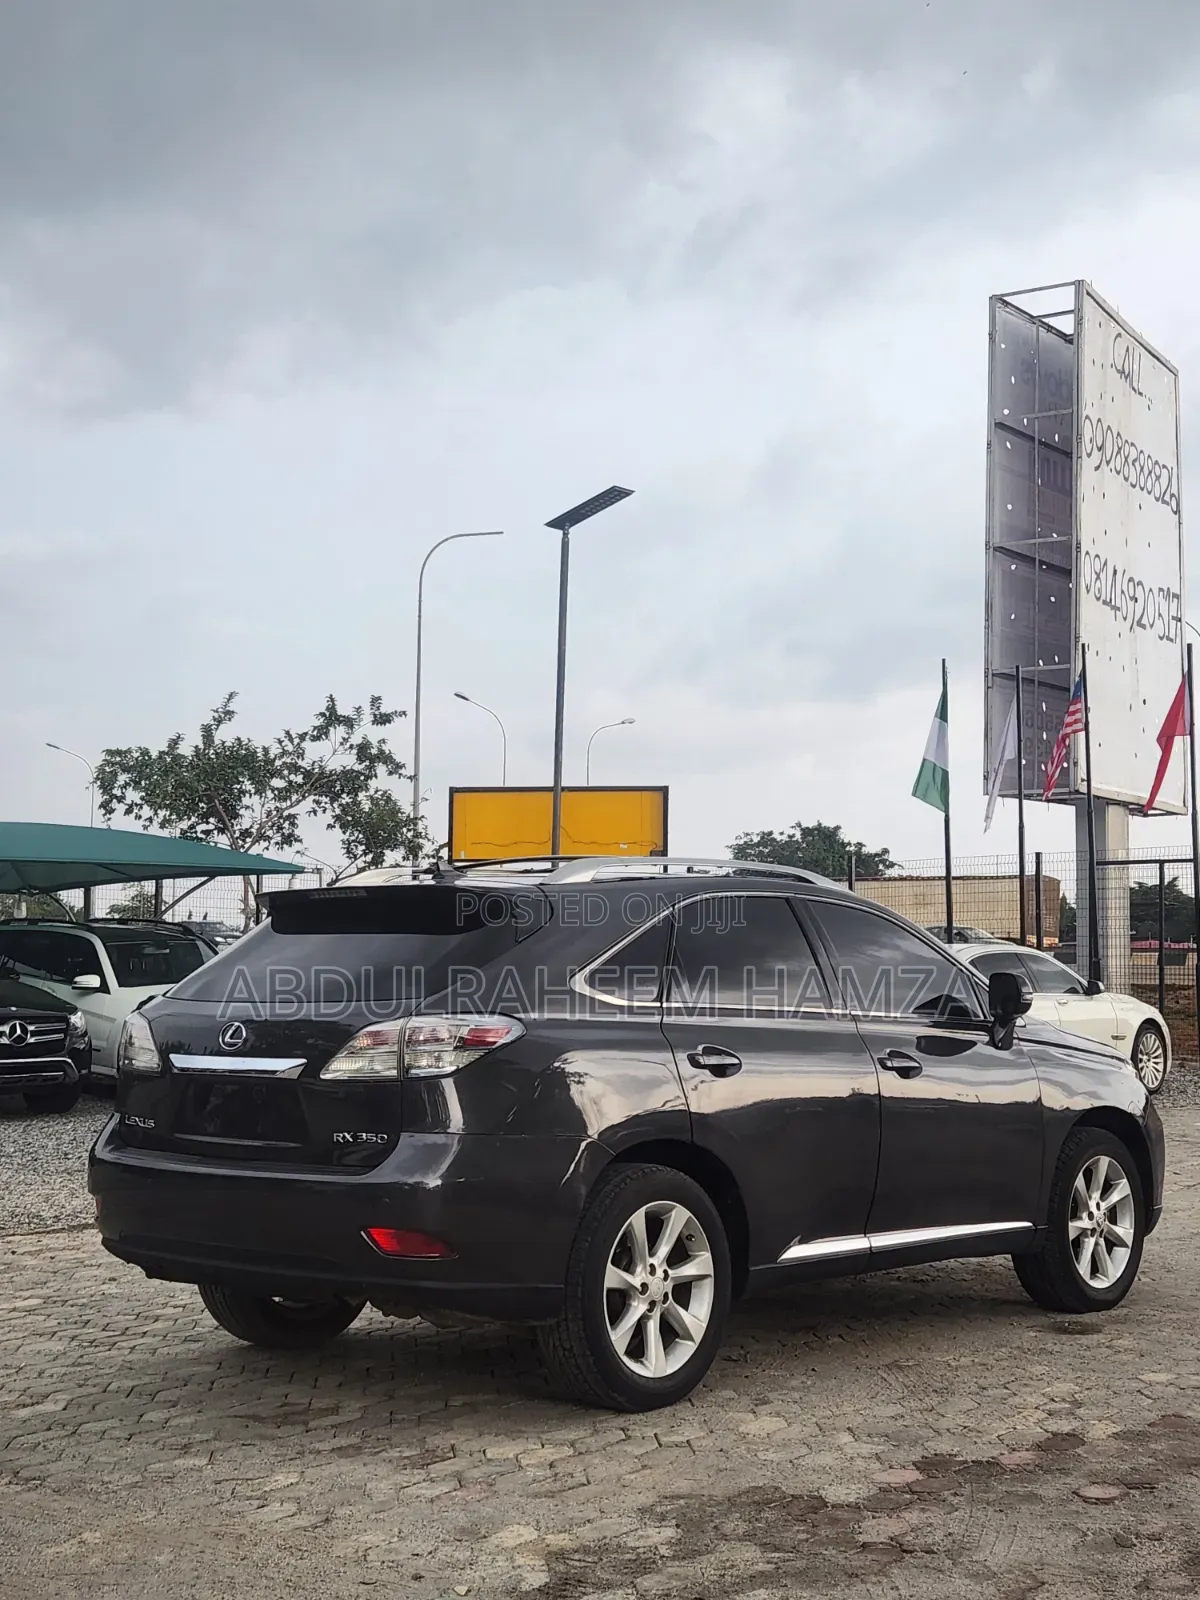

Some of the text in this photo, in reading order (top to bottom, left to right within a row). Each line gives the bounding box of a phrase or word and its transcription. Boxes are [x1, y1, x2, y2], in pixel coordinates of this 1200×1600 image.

[125, 1114, 156, 1129] LEXUS
[333, 1132, 388, 1144] RX 350
